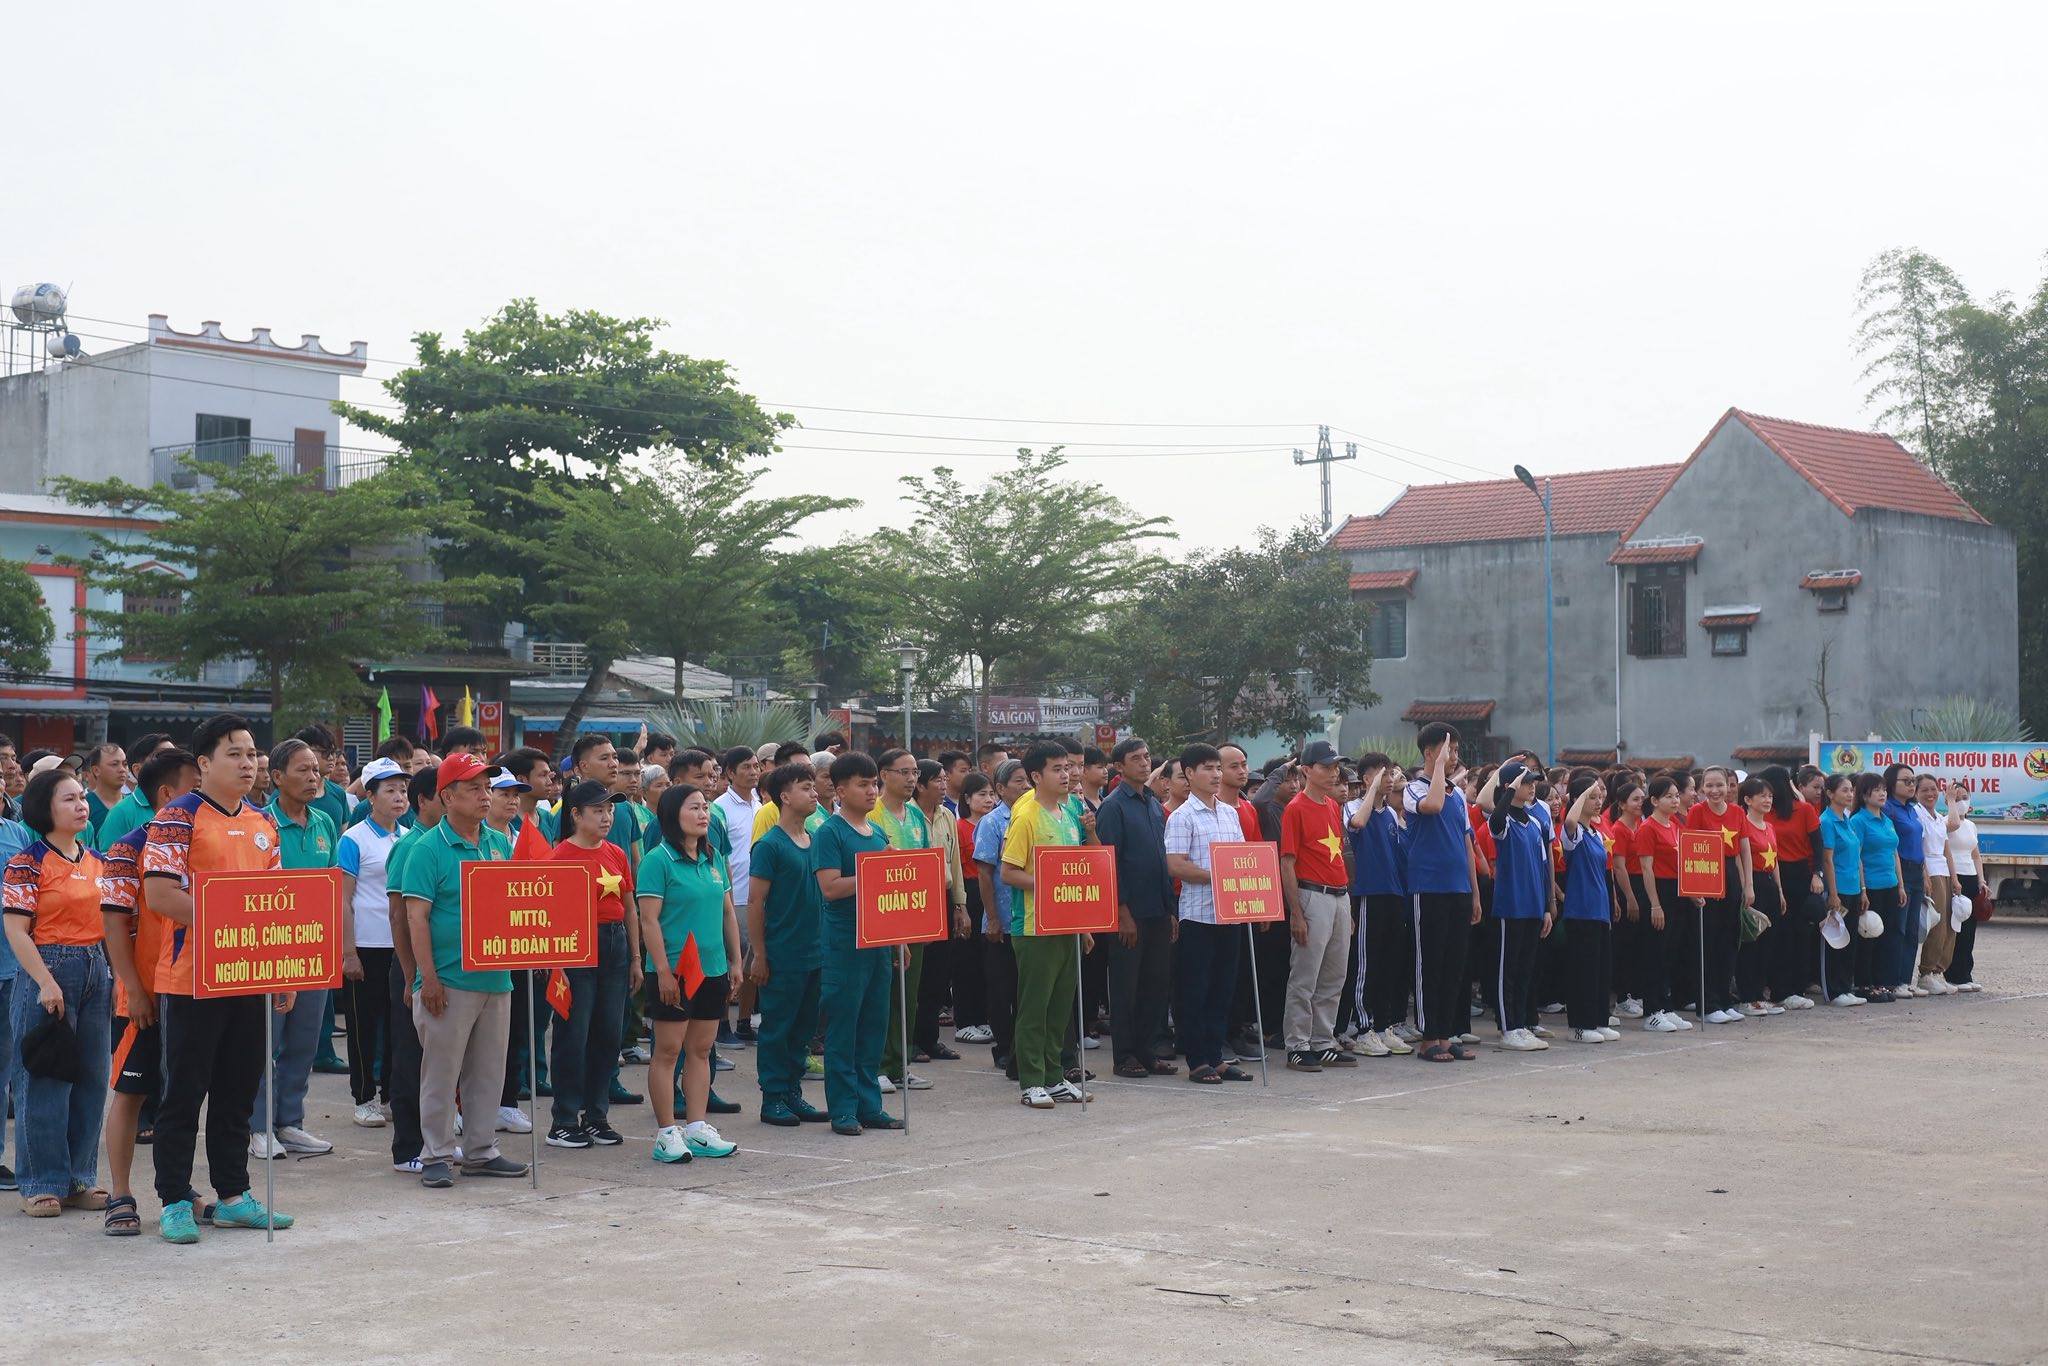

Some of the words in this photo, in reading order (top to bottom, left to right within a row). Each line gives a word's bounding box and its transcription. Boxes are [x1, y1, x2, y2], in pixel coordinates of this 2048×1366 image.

[992, 710, 1035, 724] SAIGON
[1043, 705, 1070, 718] THỊNH
[1072, 703, 1098, 715] QUÁN
[1873, 748, 1895, 766] ĐÃ
[1898, 746, 1940, 768] UỐNG
[1945, 751, 1987, 771] RƯỢU
[1992, 753, 2018, 768] BIA
[1981, 778, 2000, 793] XE
[1693, 840, 1710, 854] KHỐI
[1061, 857, 1091, 876] KHỐI
[1232, 852, 1258, 869] KHỐI
[885, 861, 917, 883] KHỐI
[506, 874, 554, 897] KHỐI
[1053, 882, 1083, 903] CÔNG
[1085, 885, 1100, 902] AN
[1239, 875, 1258, 892] NHÂN
[1258, 874, 1272, 891] DÂN
[243, 885, 296, 913] KHỐI
[877, 889, 909, 914] QUÂN
[911, 889, 927, 912] SỰ
[1233, 898, 1248, 915] CÁC
[1248, 898, 1266, 914] THÔN
[510, 909, 551, 928] MTTQ,
[214, 924, 238, 949] CÁN
[240, 922, 259, 951] BỘ,
[262, 921, 292, 946] CÔNG
[295, 919, 324, 944] CHỨC
[482, 935, 507, 959] HỘI
[510, 934, 549, 955] ĐOÀN
[552, 930, 579, 953] THỂ
[215, 957, 249, 983] NGƯỜI
[252, 960, 273, 981] LAO
[276, 954, 306, 983] ĐỘNG
[308, 953, 324, 977] XÃ
